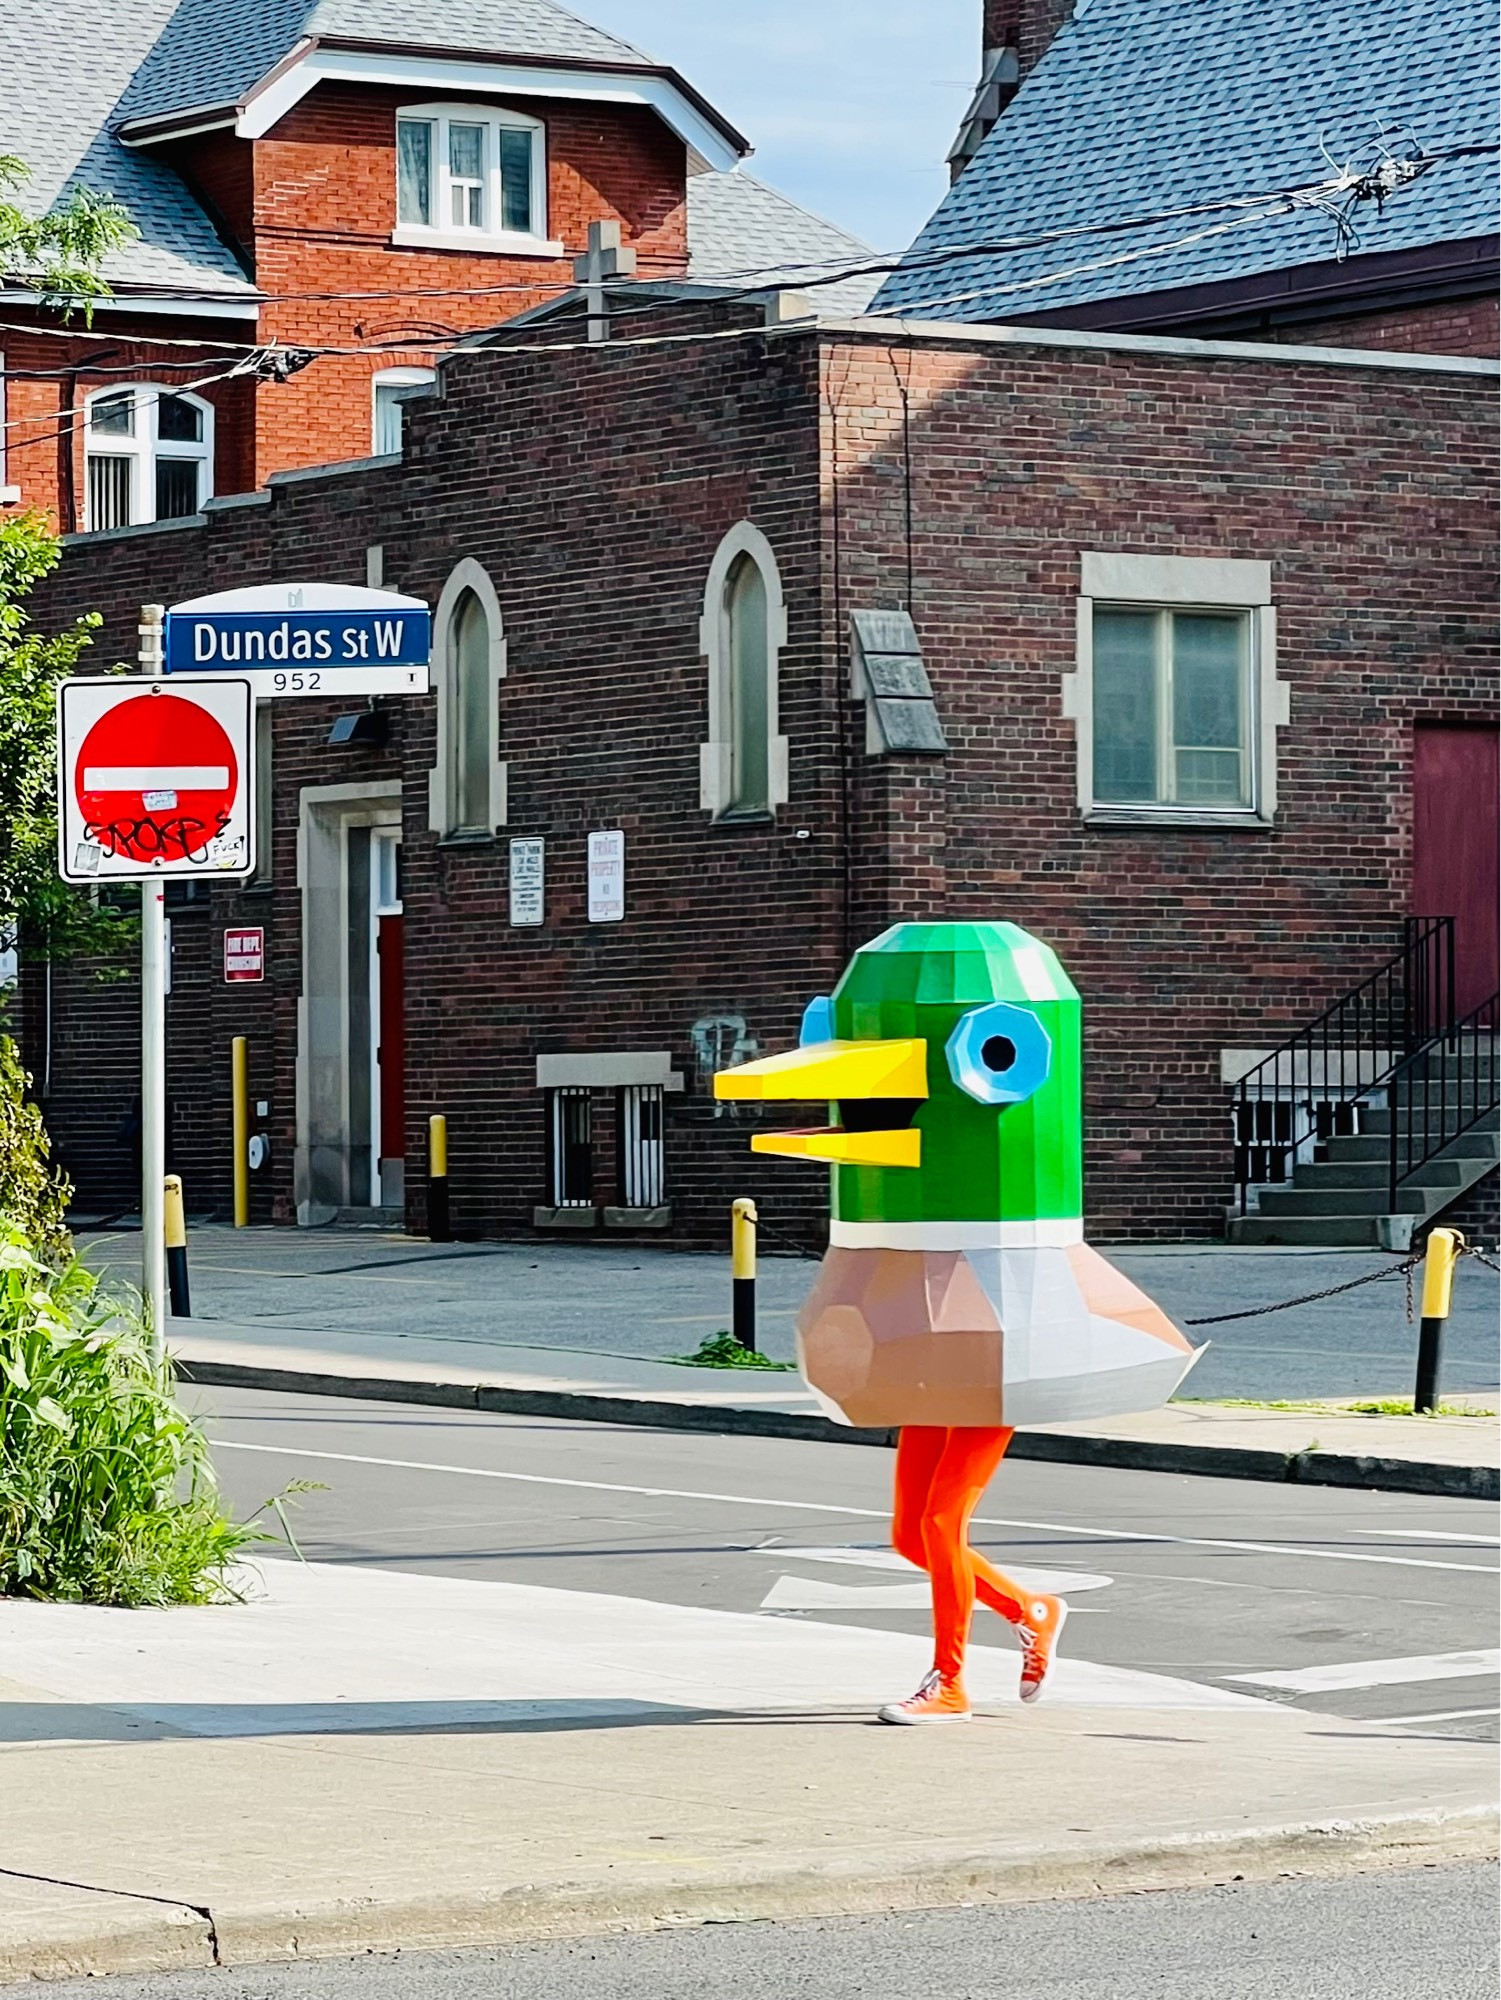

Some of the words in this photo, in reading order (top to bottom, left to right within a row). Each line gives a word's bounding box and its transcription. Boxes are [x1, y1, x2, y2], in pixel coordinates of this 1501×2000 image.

[194, 622, 332, 662] Dundas
[342, 628, 369, 659] St
[374, 620, 404, 658] W
[273, 672, 321, 691] 952
